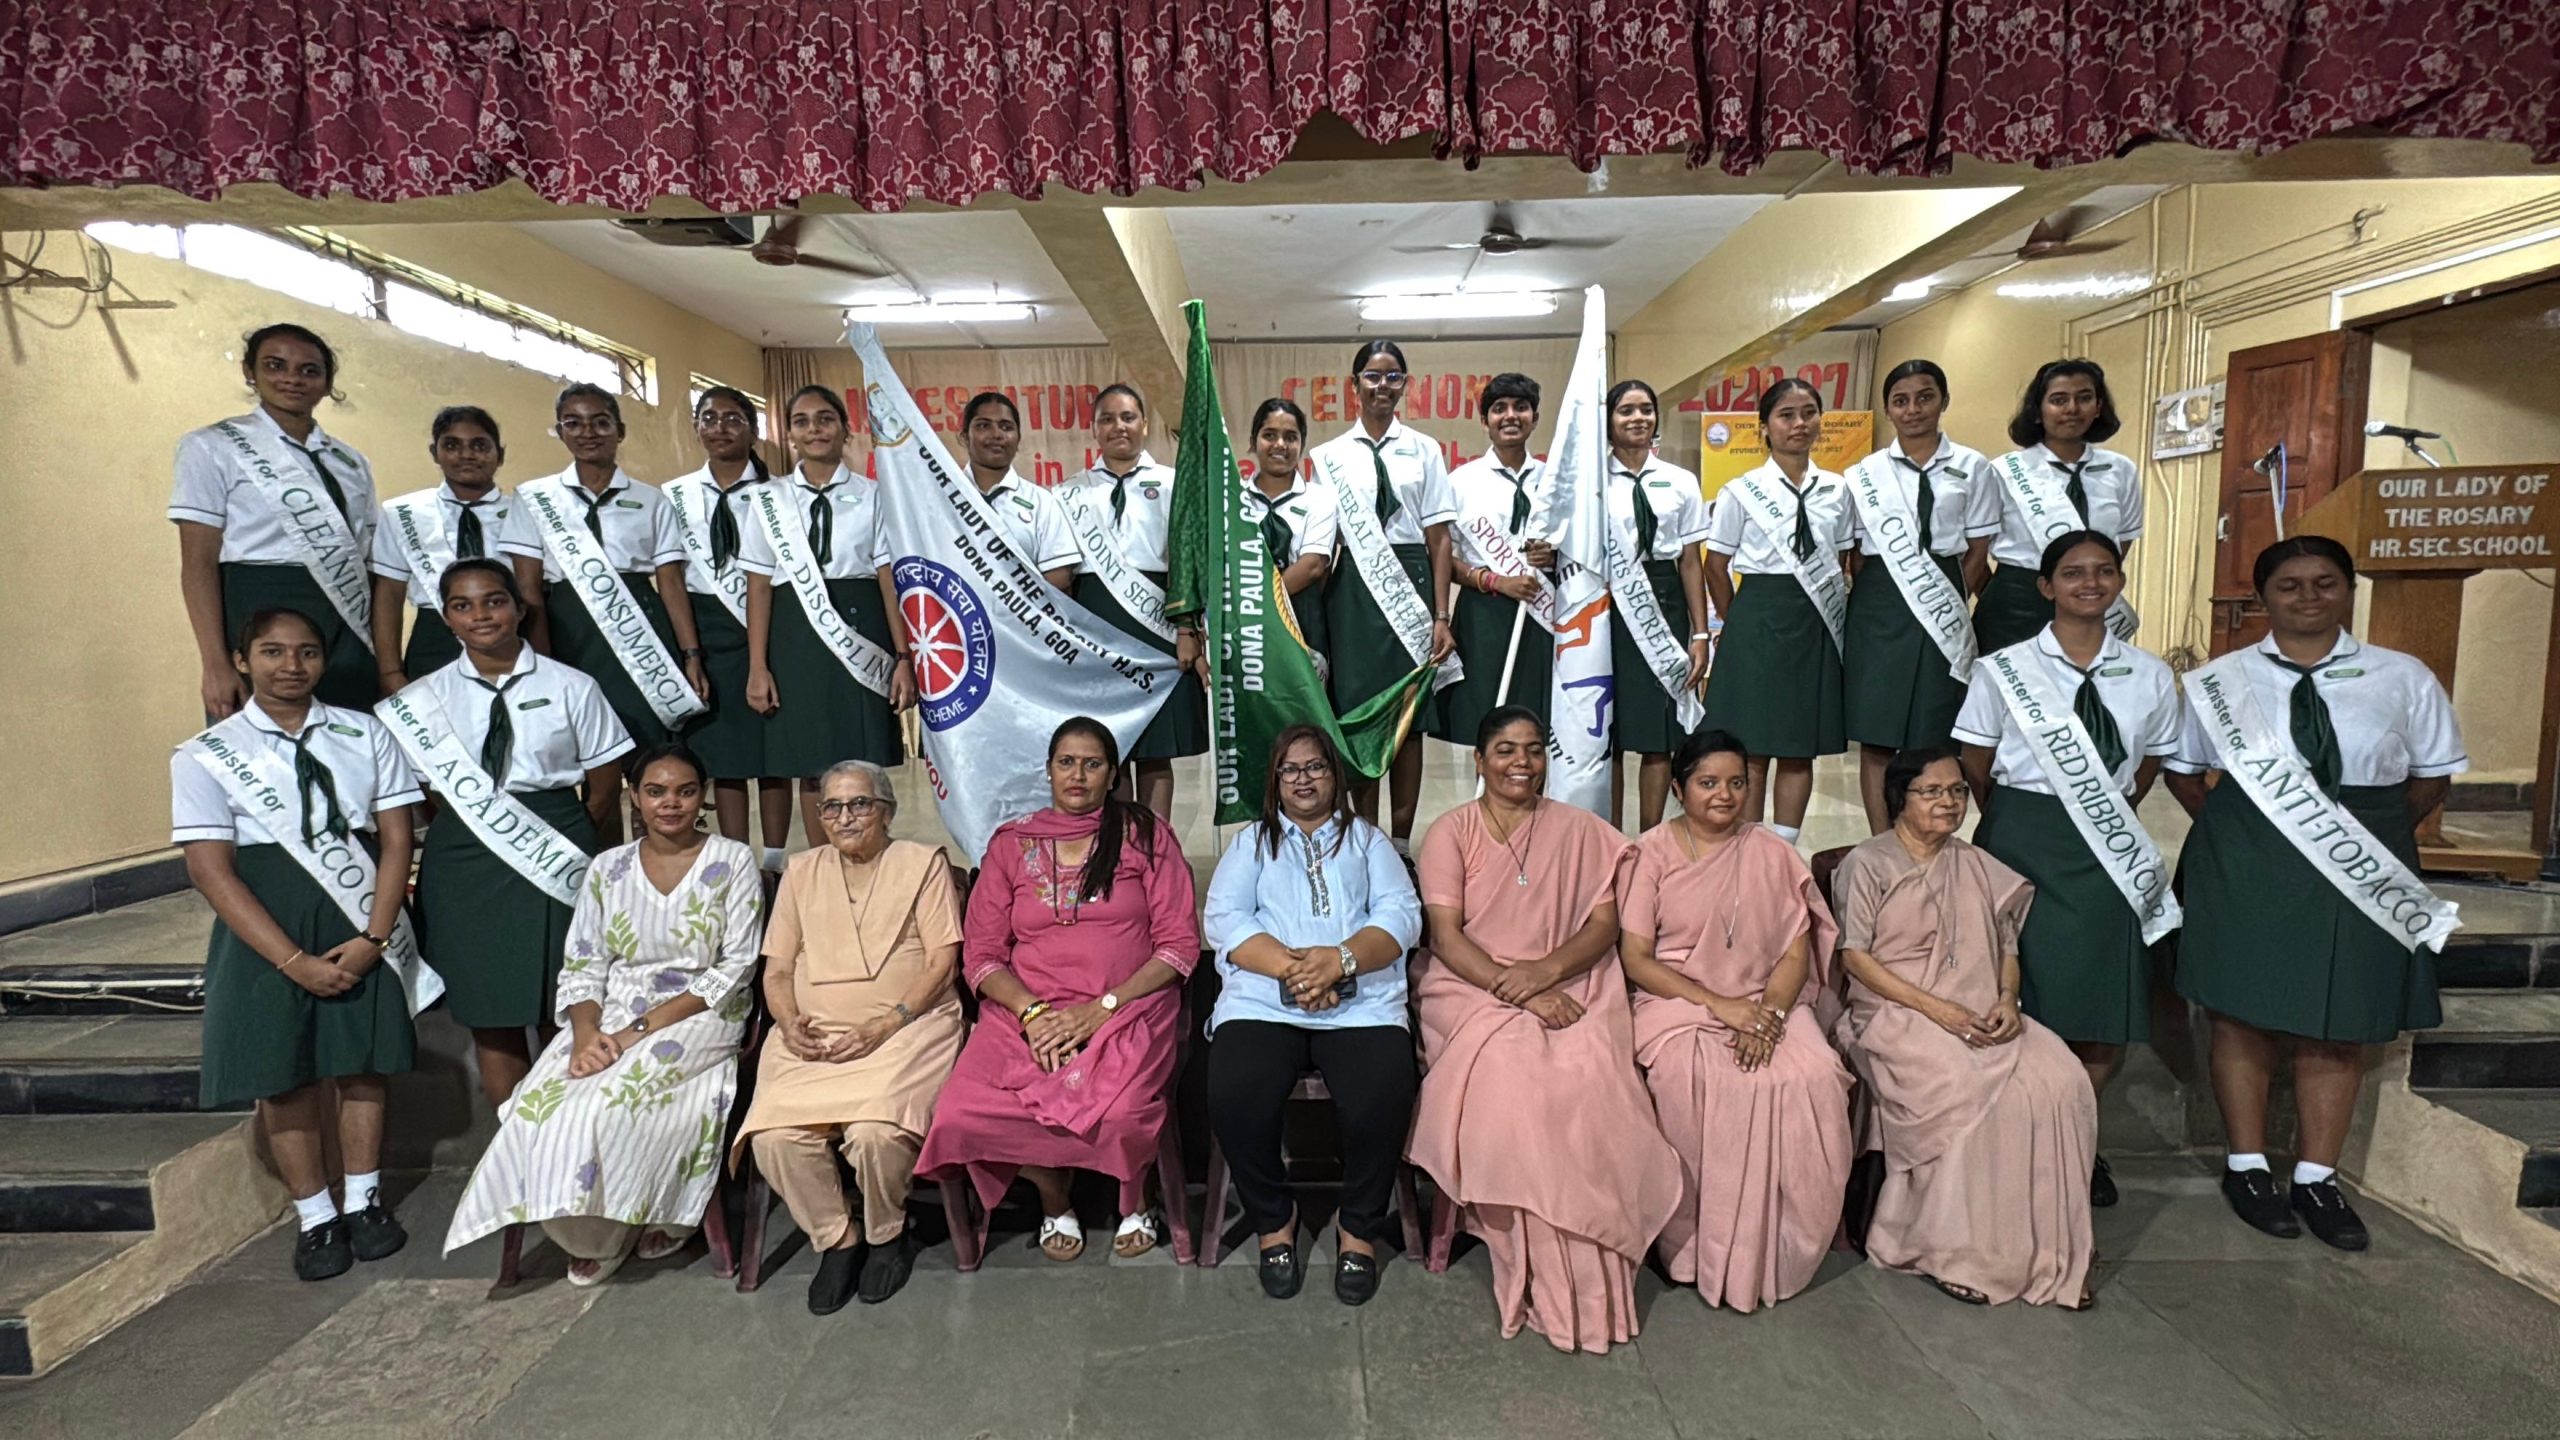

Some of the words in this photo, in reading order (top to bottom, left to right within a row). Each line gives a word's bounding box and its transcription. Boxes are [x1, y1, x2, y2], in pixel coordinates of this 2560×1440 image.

[1034, 453, 1064, 486] in
[2378, 478, 2427, 498] OUR
[2435, 475, 2507, 497] LADY
[2514, 474, 2550, 494] OF
[253, 459, 279, 479] for
[281, 487, 370, 625] CLEANLIN
[396, 504, 422, 552] Minister
[417, 554, 437, 575] for
[533, 492, 566, 533] Minister
[562, 536, 582, 556] for
[671, 485, 690, 532] Minister
[685, 531, 702, 551] for
[1765, 501, 1784, 518] for
[2028, 497, 2046, 517] for
[2384, 508, 2432, 528] THE
[2436, 505, 2535, 527] ROSARY
[948, 491, 991, 537] LADY
[986, 534, 1016, 565] OF
[1010, 561, 1045, 603] THE
[1082, 525, 1126, 583] JOINT
[1865, 489, 1880, 508] for
[1880, 516, 1963, 639] CULTURE
[759, 490, 784, 539] Minister
[779, 542, 795, 563] for
[793, 563, 891, 684] DISCIPLIN
[954, 534, 994, 583] DONA
[992, 579, 1042, 637] PAULA,
[1044, 630, 1080, 665] GOA
[1369, 553, 1434, 656] SECRETA
[947, 577, 977, 616] सेवा
[969, 616, 993, 680] योजना
[1240, 624, 1264, 691] DONA
[1624, 580, 1687, 692] SECRETAR
[1991, 651, 2031, 703] Minister
[2024, 700, 2047, 725] for
[196, 731, 263, 788] Minister
[257, 785, 286, 814] for
[414, 728, 434, 751] for
[2201, 673, 2234, 727] Minister
[2218, 725, 2248, 752] for
[2244, 757, 2433, 935] ANTI-TOBACCO
